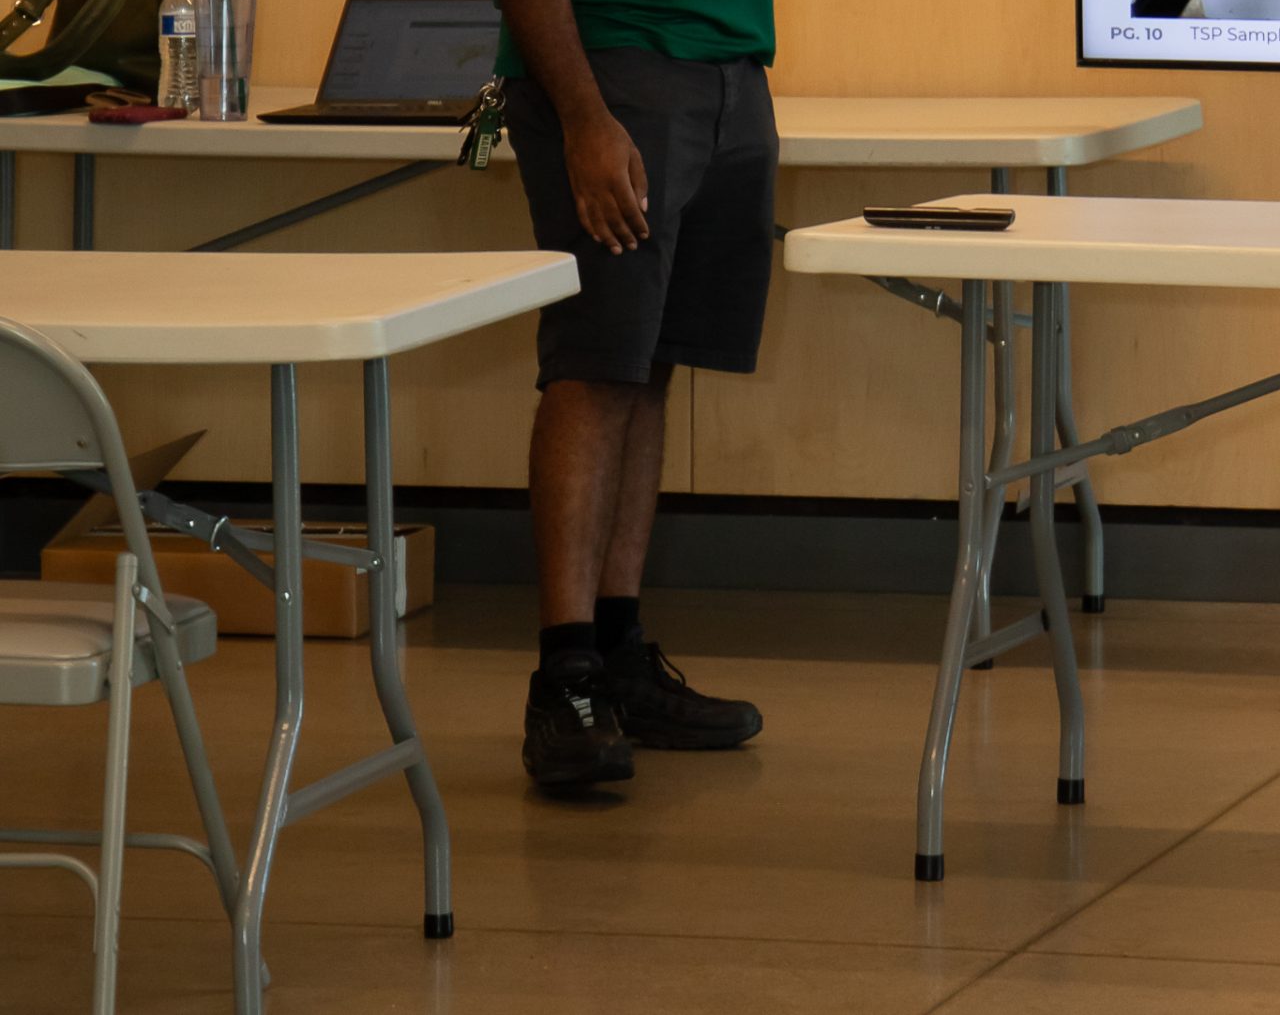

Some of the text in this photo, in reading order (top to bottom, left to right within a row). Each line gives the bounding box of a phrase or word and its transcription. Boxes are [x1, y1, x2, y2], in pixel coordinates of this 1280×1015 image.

[1110, 25, 1164, 42] PG. 10
[1189, 26, 1223, 42] TSP
